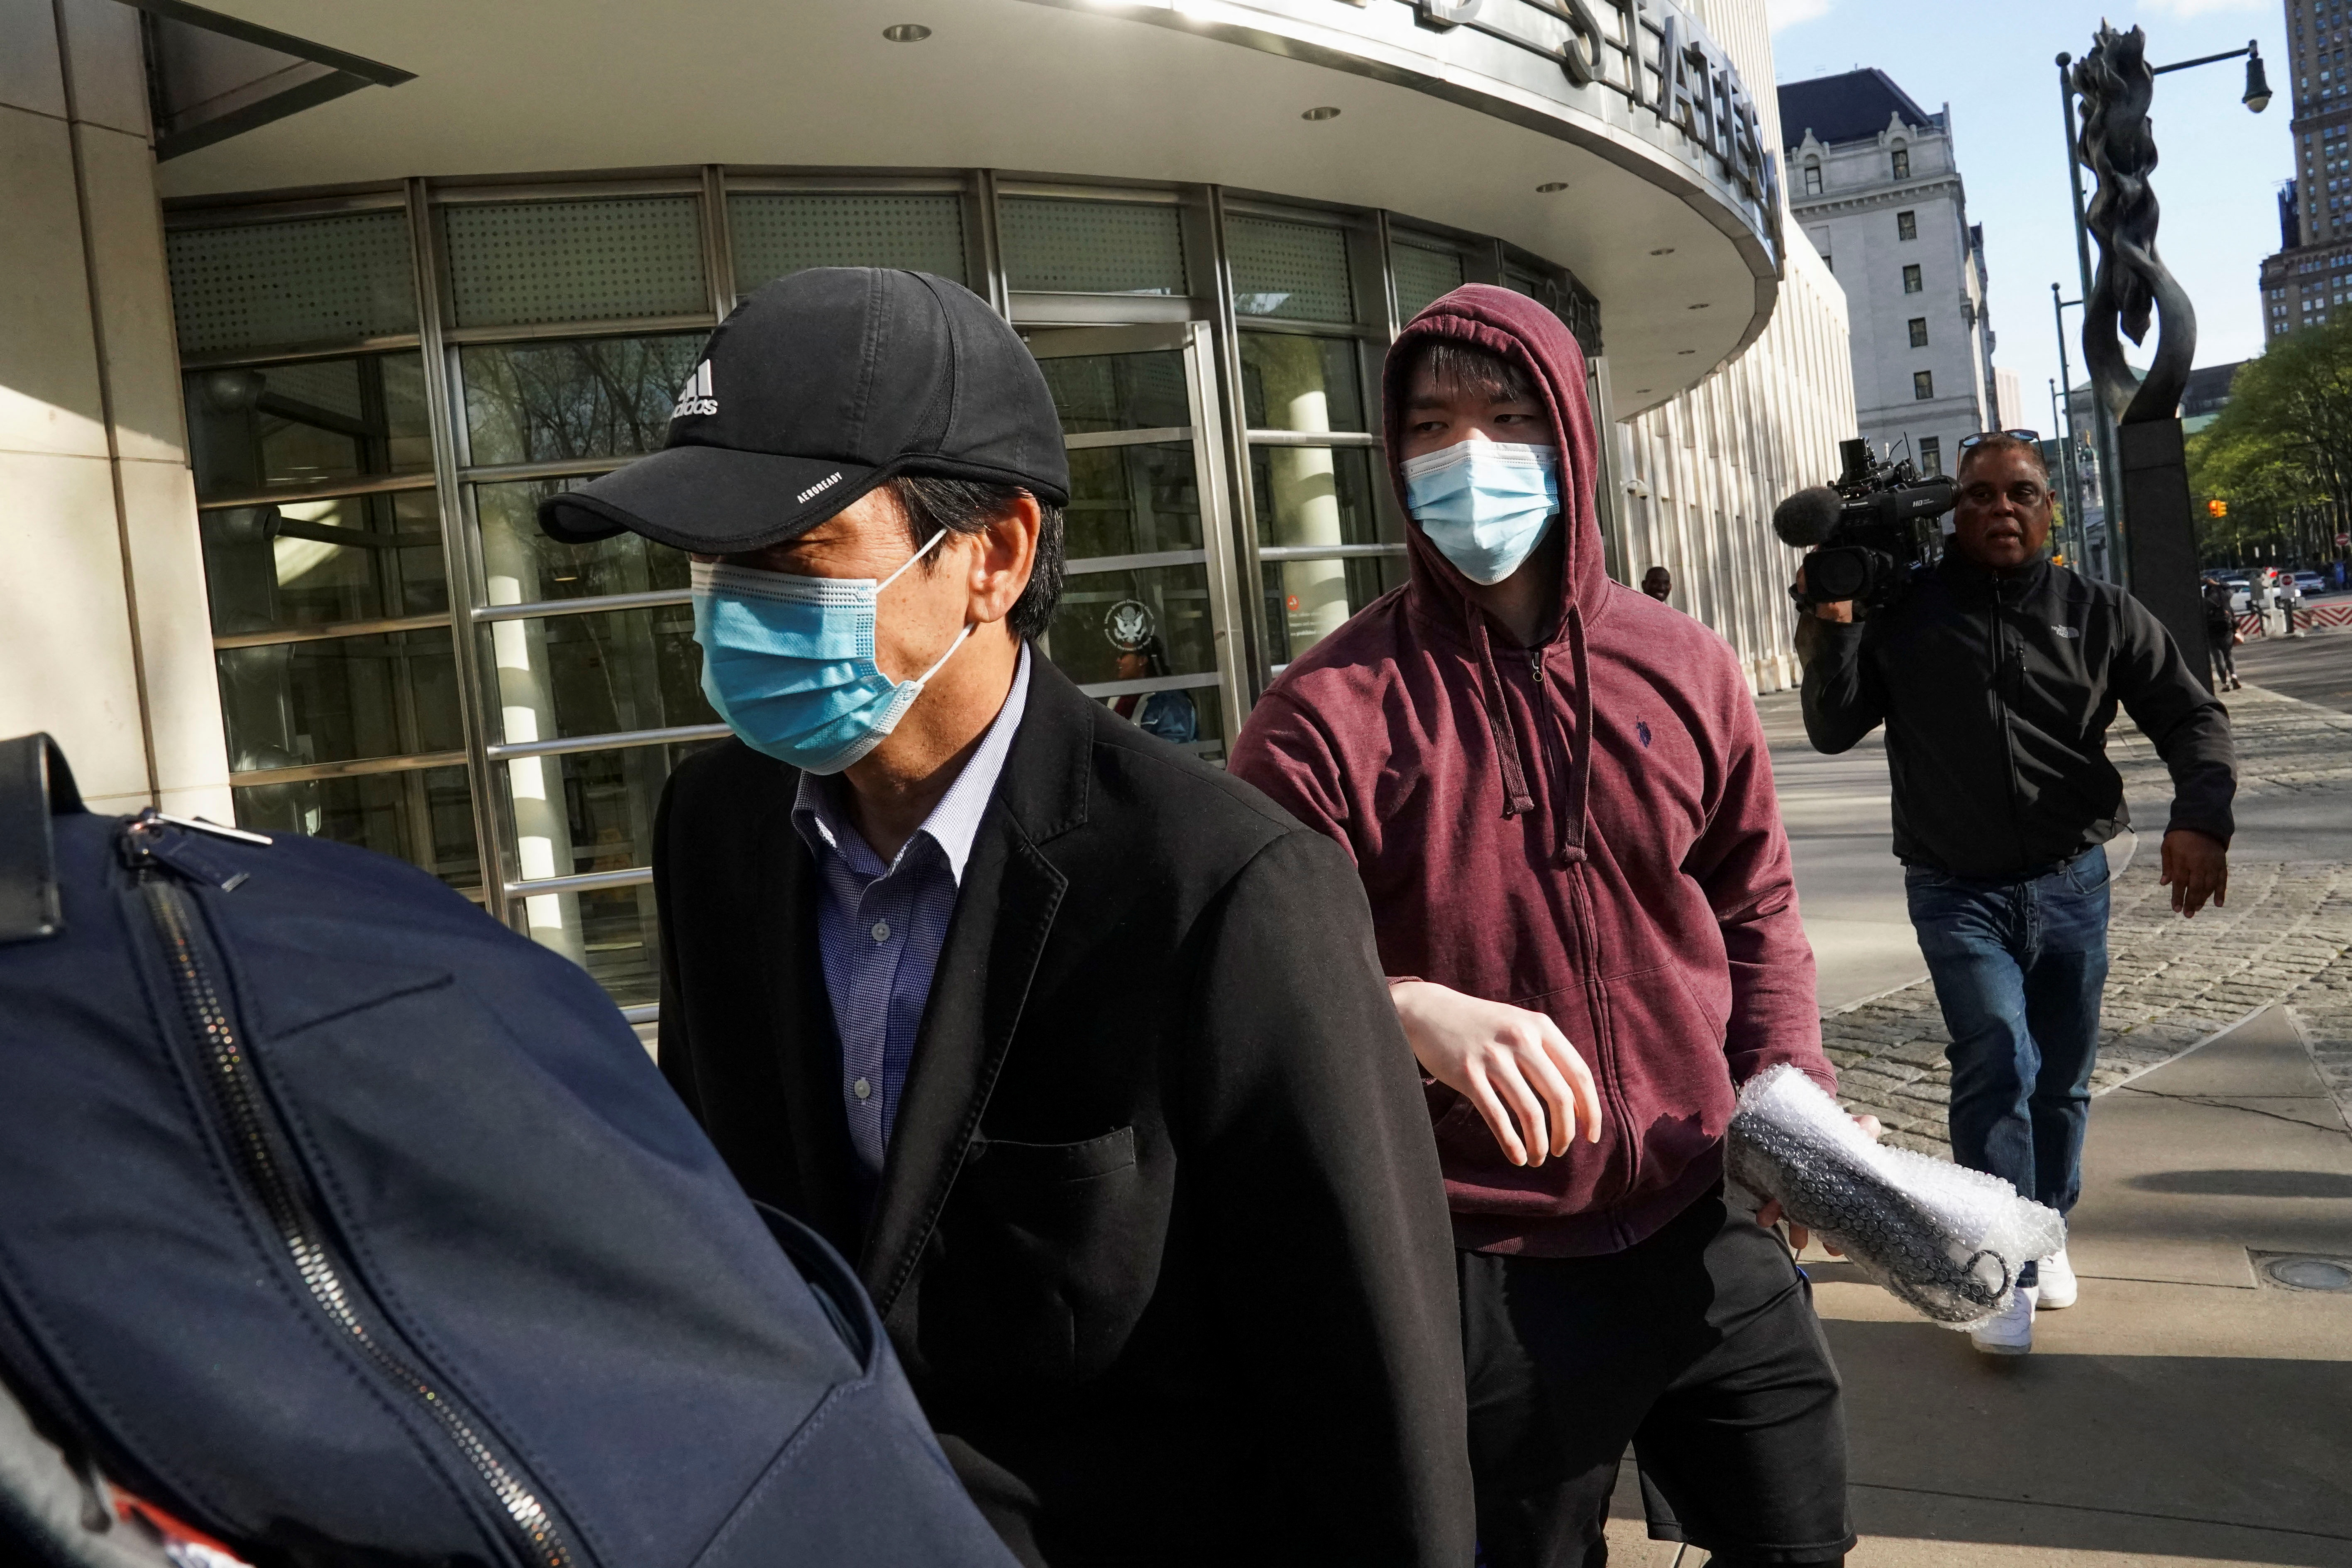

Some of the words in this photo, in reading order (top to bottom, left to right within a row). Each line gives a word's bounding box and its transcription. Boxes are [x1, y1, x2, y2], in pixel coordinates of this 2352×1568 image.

[1556, 0, 1768, 199] STATES
[669, 395, 718, 421] didas
[797, 471, 843, 504] AEROREADY
